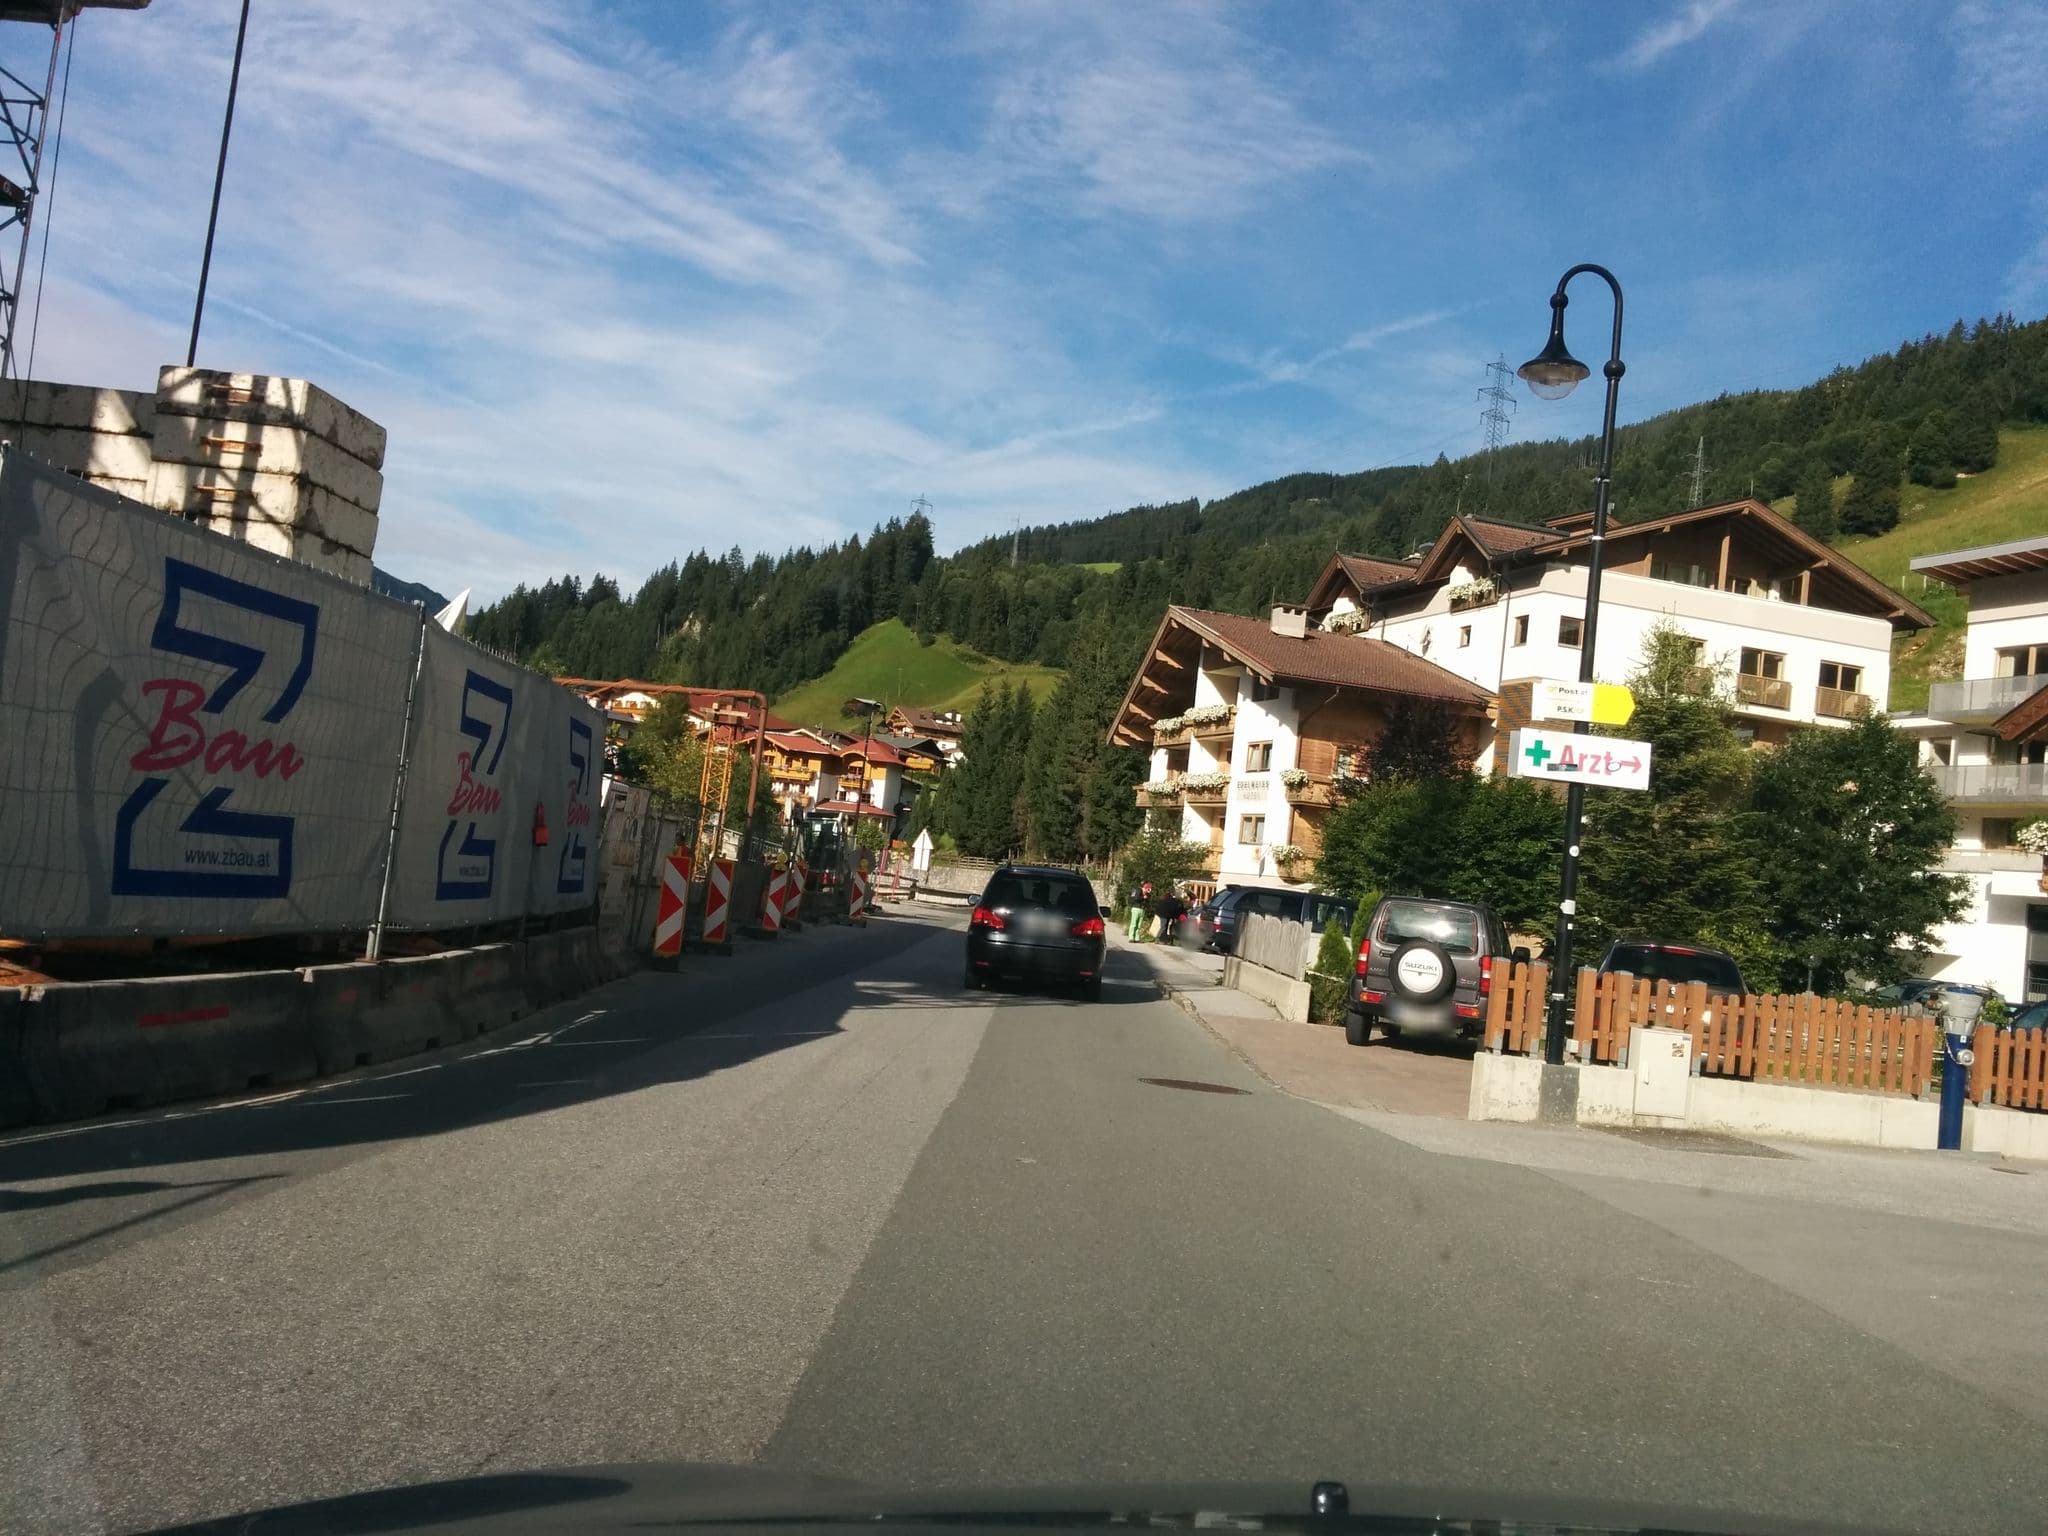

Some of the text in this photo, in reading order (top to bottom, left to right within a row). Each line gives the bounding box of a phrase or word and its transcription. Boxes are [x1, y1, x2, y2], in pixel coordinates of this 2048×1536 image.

[130, 678, 304, 781] Bau
[1560, 744, 1613, 776] Arzt
[447, 751, 502, 816] Bau
[184, 847, 271, 869] www.zbau.at
[1404, 961, 1438, 972] SUZUKI
